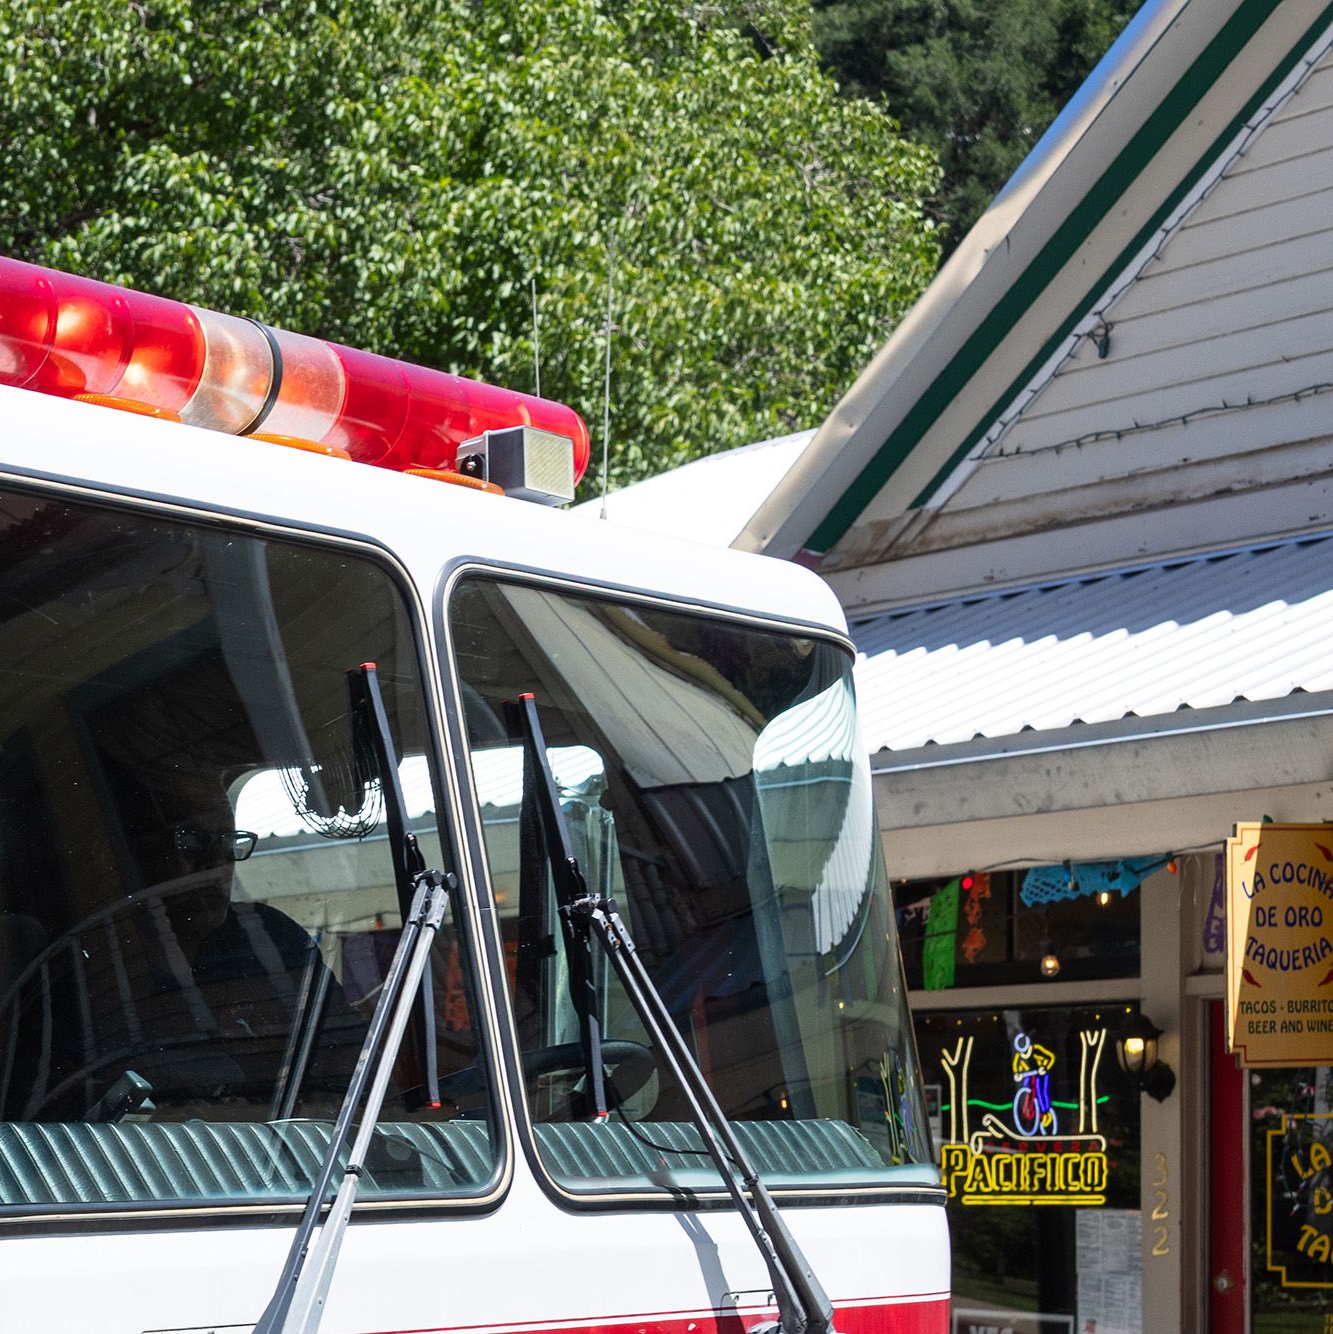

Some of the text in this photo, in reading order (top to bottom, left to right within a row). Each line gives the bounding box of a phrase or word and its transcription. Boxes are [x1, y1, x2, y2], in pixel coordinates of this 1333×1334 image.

[1242, 872, 1265, 900] LA
[1256, 906, 1323, 927] DE ORO
[1246, 936, 1333, 971] TAQUERIA
[1240, 1001, 1277, 1014] TACOS
[1248, 1020, 1333, 1034] BEER AND WINE
[941, 1144, 1109, 1198] PACIFICO
[1291, 1142, 1332, 1180] LA
[1296, 1223, 1333, 1263] TA
